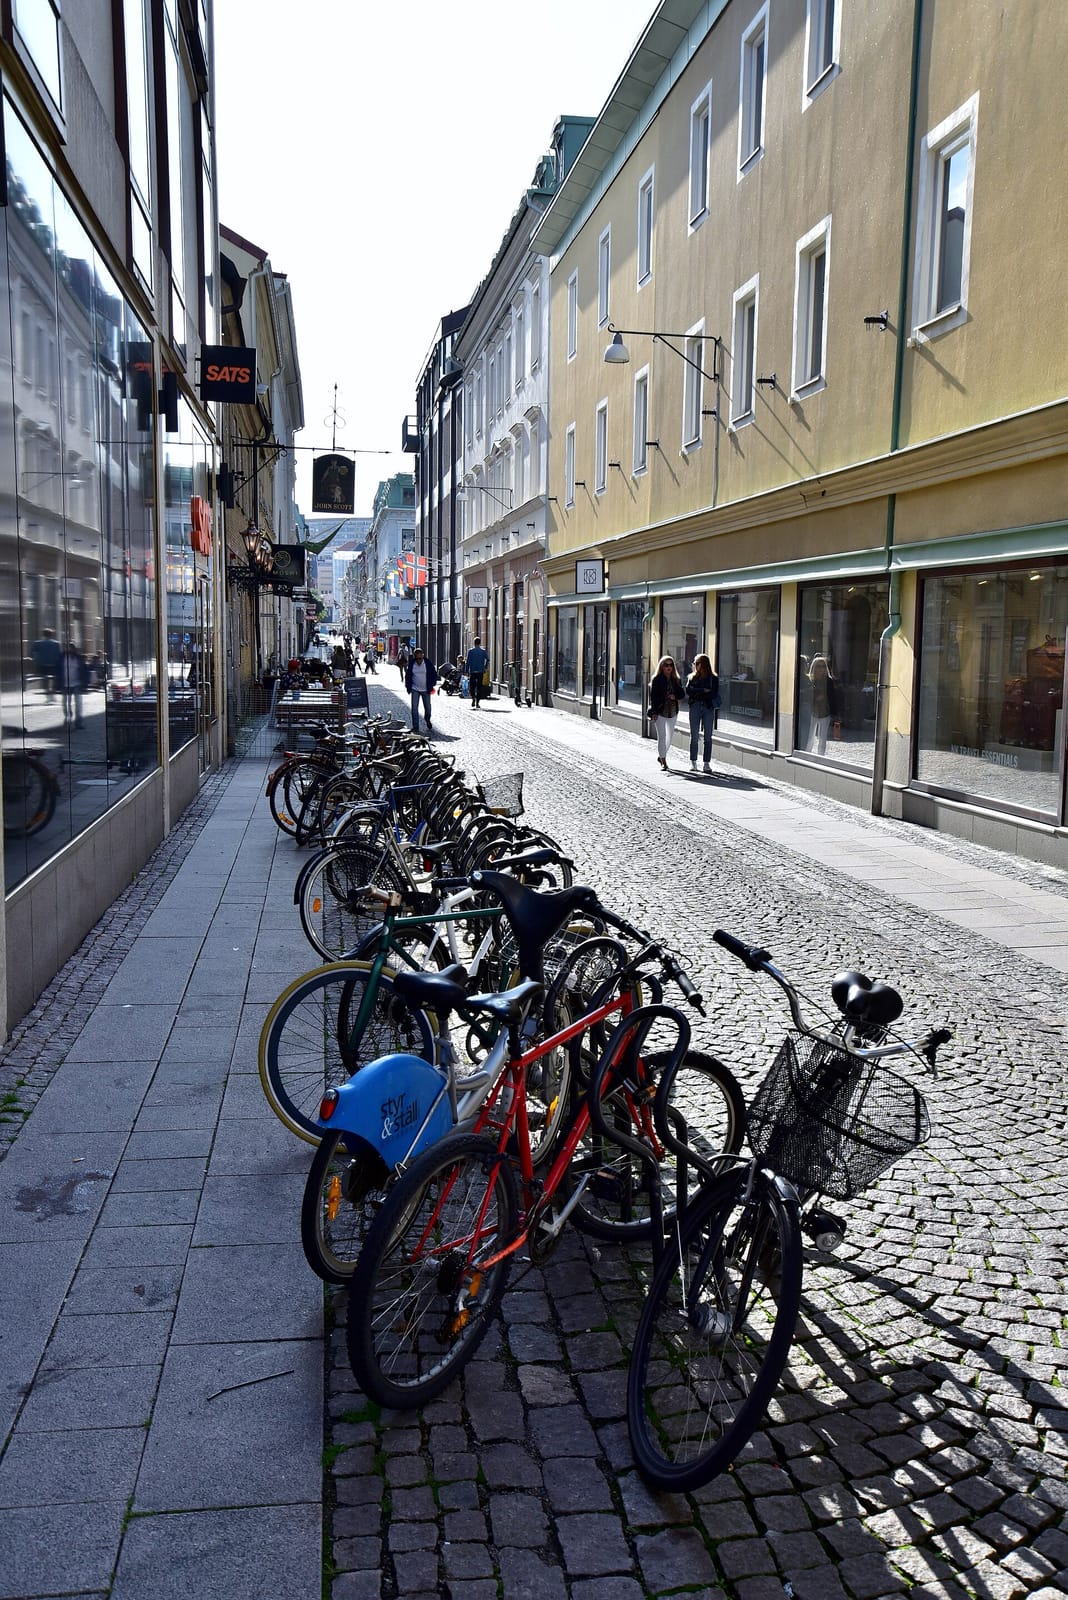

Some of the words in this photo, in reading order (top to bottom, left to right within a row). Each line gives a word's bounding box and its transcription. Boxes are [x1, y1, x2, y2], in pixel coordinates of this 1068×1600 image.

[206, 364, 251, 384] SATS
[314, 502, 333, 510] JOHN
[333, 503, 353, 511] SCOTT
[960, 745, 980, 758] TRAVEL
[981, 749, 1018, 769] ESSENTIALS
[381, 1092, 406, 1119] styr
[381, 1117, 394, 1140] &
[394, 1100, 418, 1132] ställ
